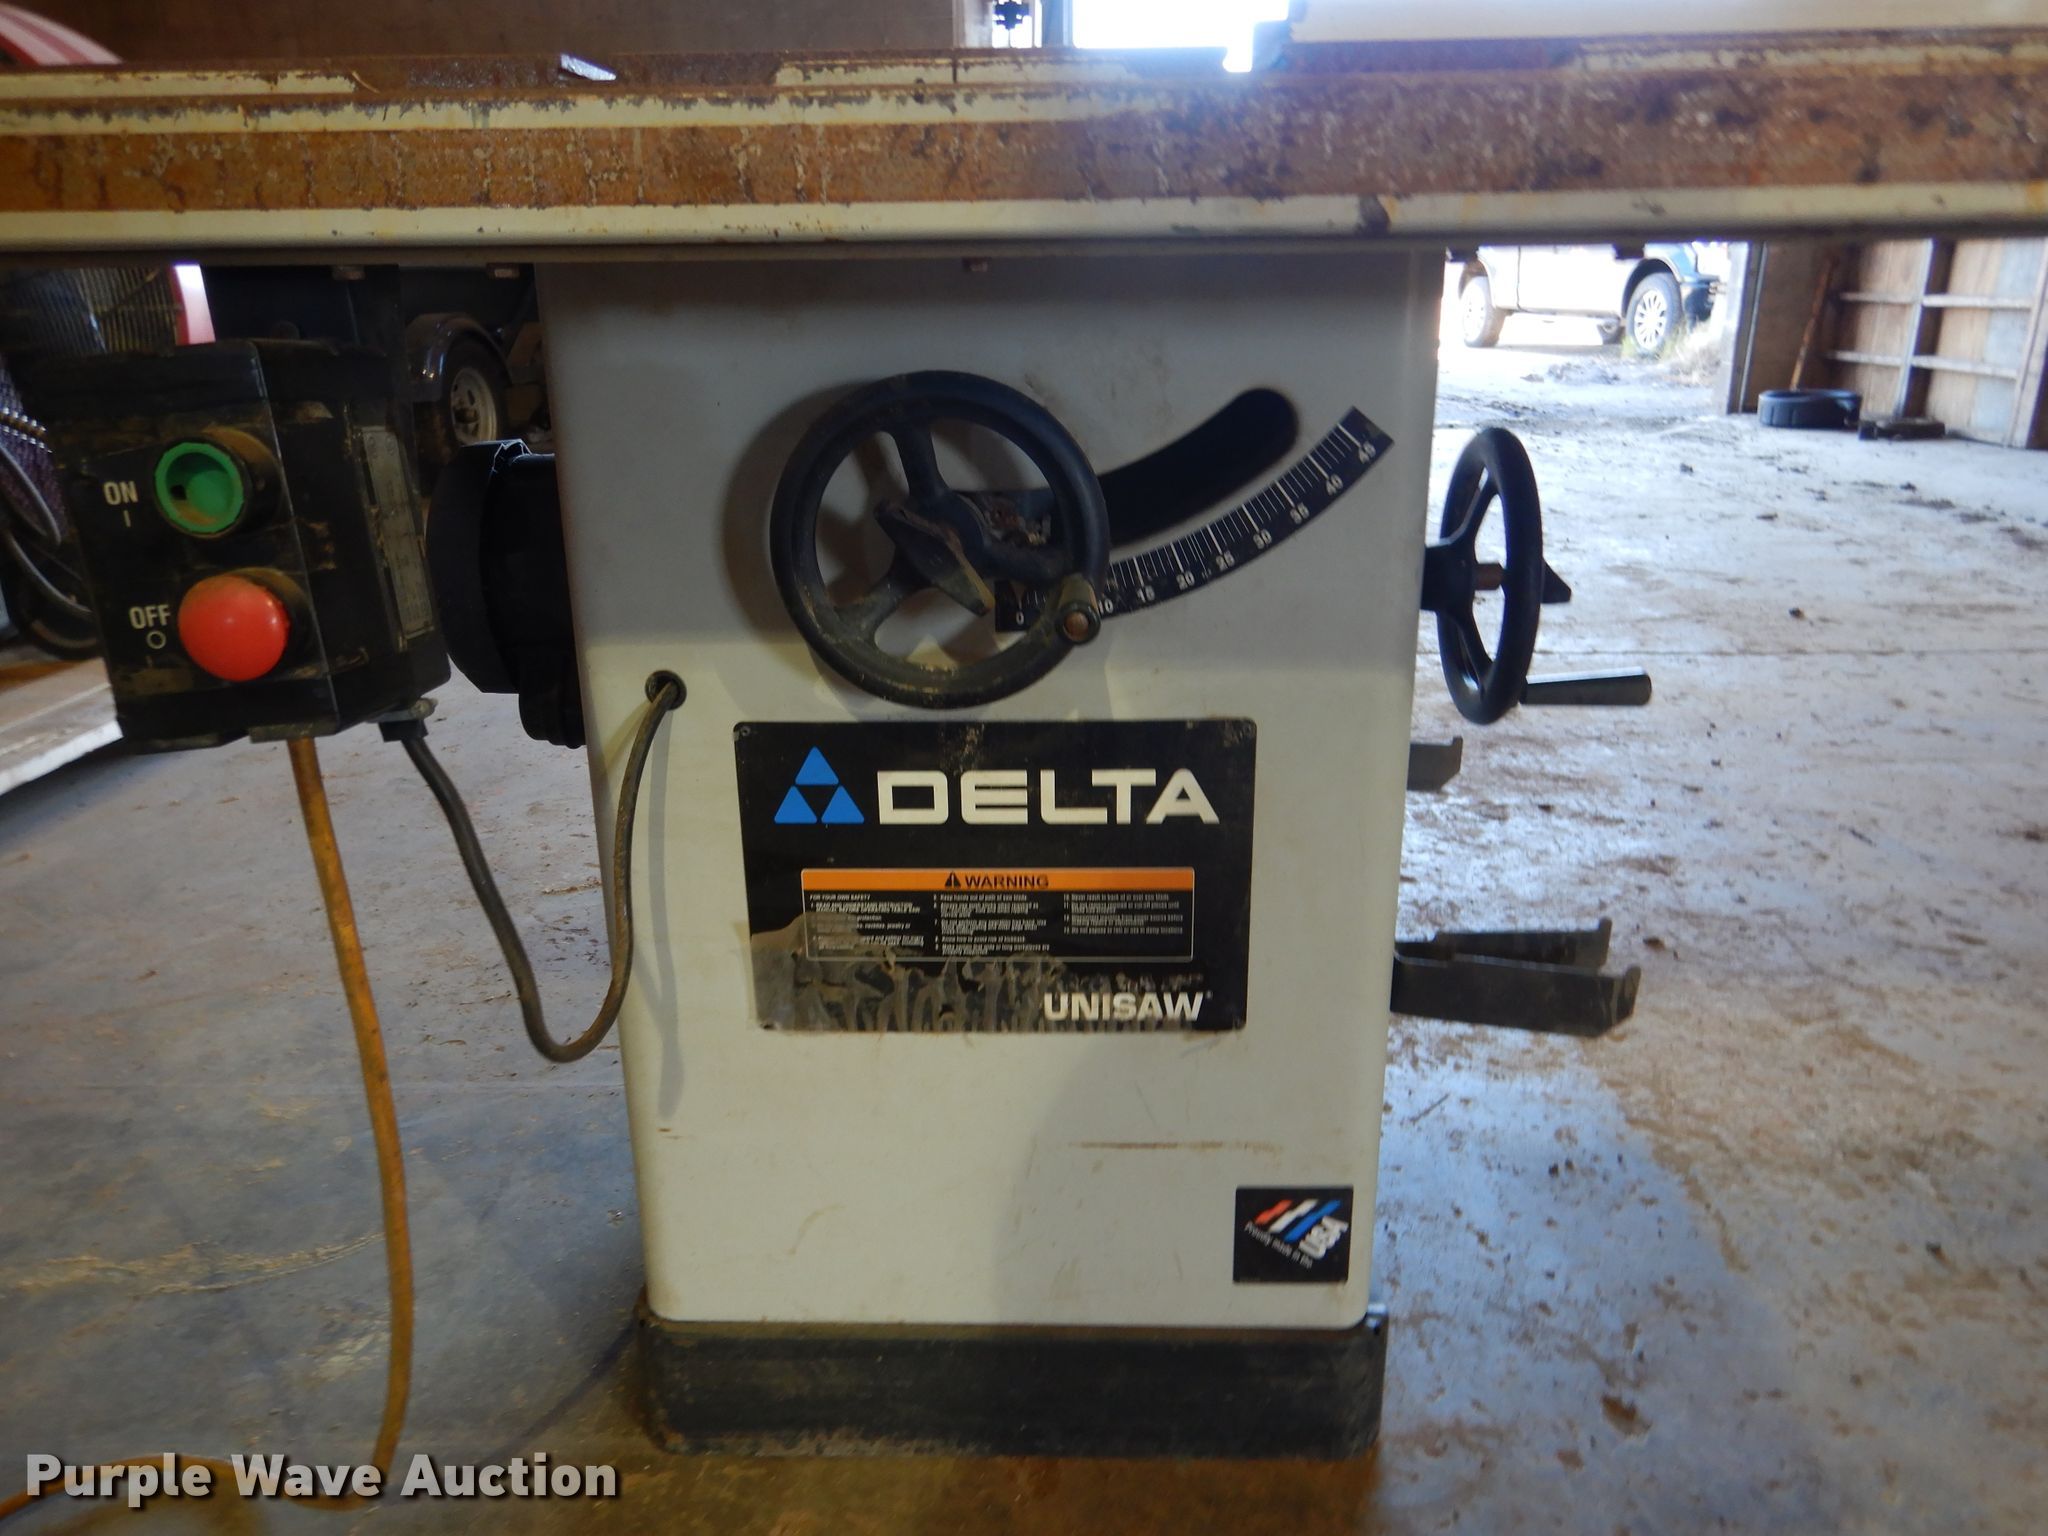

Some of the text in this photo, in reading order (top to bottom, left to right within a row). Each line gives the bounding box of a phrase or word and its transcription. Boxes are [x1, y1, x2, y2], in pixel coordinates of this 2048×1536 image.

[103, 480, 139, 505] ON
[1176, 570, 1195, 590] 20
[1326, 474, 1343, 496] 40
[128, 604, 171, 629] OFF
[877, 768, 1220, 825] DELTA
[965, 873, 1049, 889] WARNING
[1044, 991, 1204, 1022] UNISAW
[1299, 1215, 1349, 1260] USA
